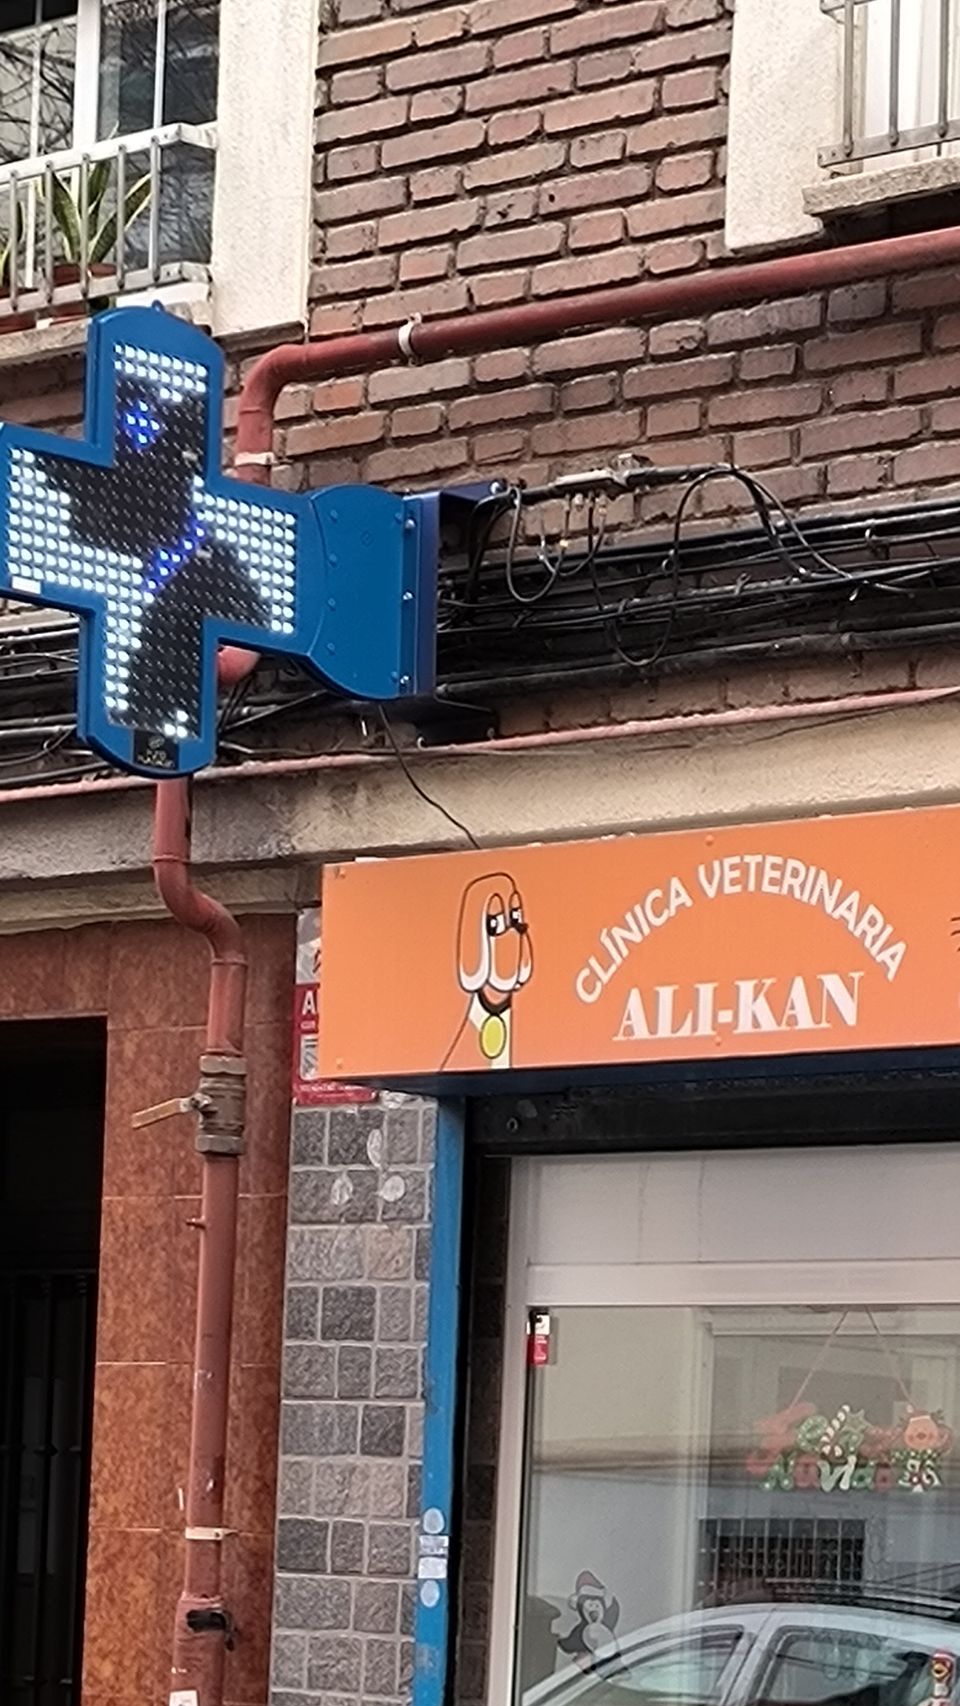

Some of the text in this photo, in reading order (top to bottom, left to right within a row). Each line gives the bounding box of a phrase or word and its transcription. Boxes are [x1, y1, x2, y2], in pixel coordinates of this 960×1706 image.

[575, 854, 909, 1004] CLÍNICA VETERINARIA
[612, 972, 865, 1042] ALI-KAN
